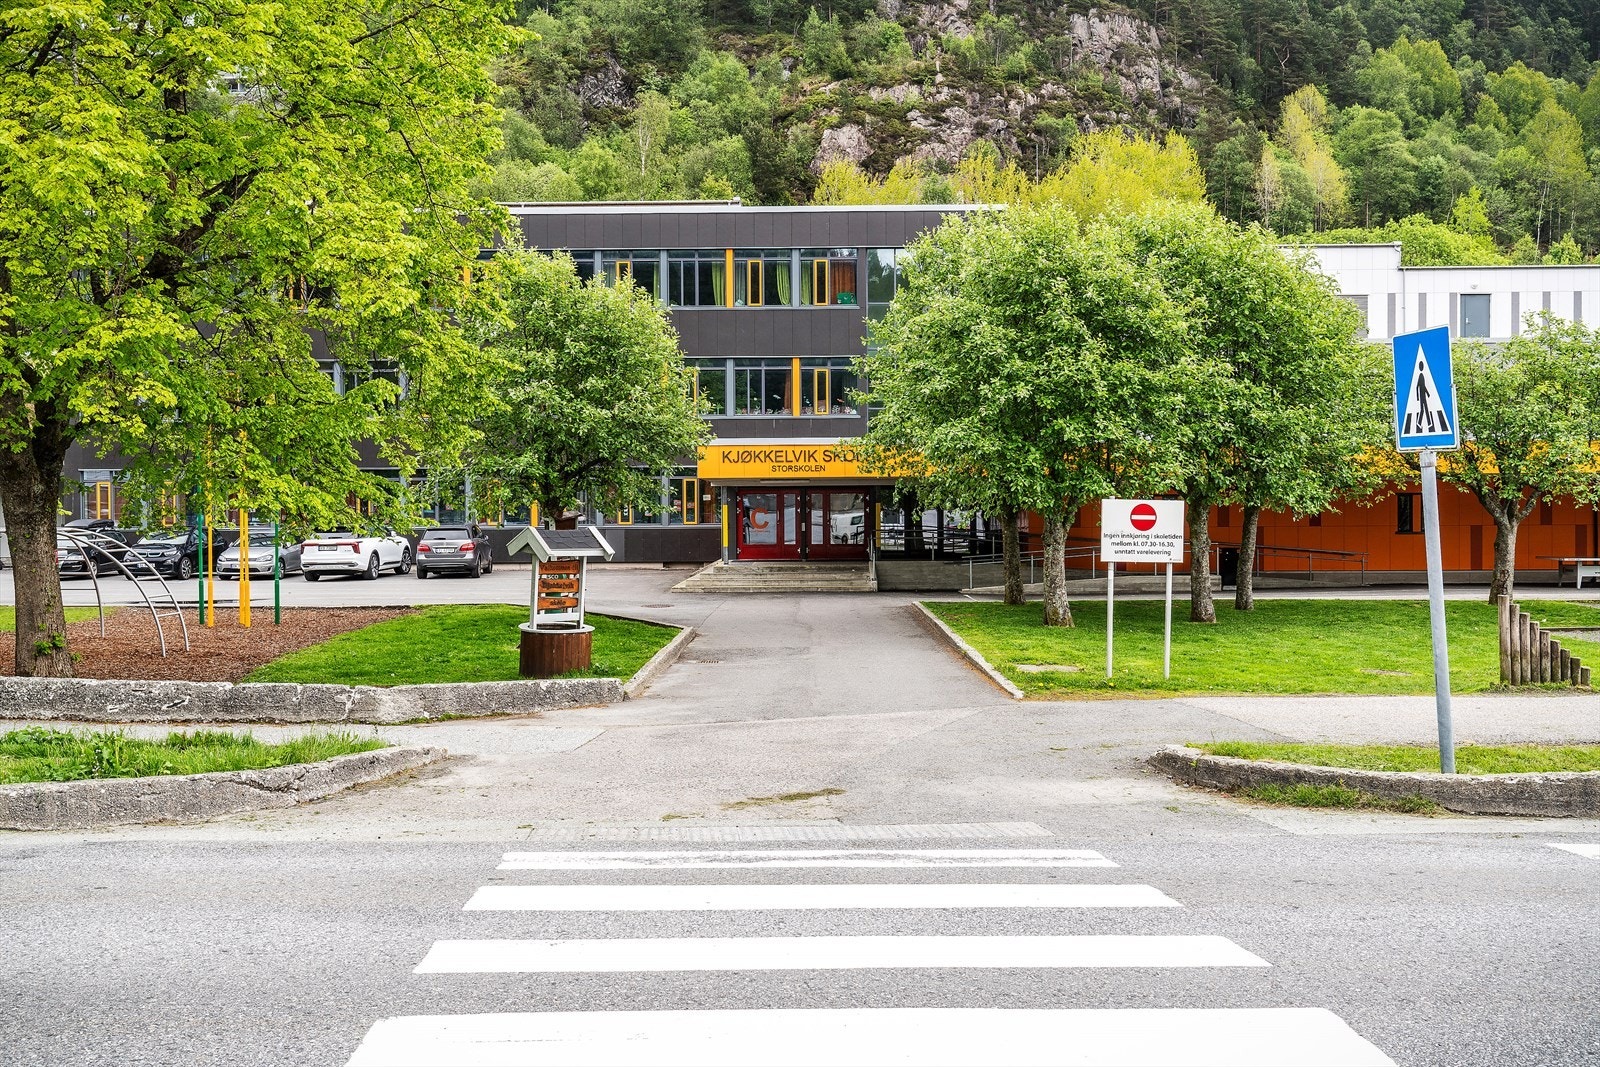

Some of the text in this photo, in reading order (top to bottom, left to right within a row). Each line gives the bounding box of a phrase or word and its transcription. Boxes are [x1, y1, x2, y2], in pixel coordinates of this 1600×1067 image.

[722, 450, 818, 463] KJØKKELVIK
[771, 465, 826, 473] STORSKOLEN
[1136, 549, 1172, 557] varelevering
